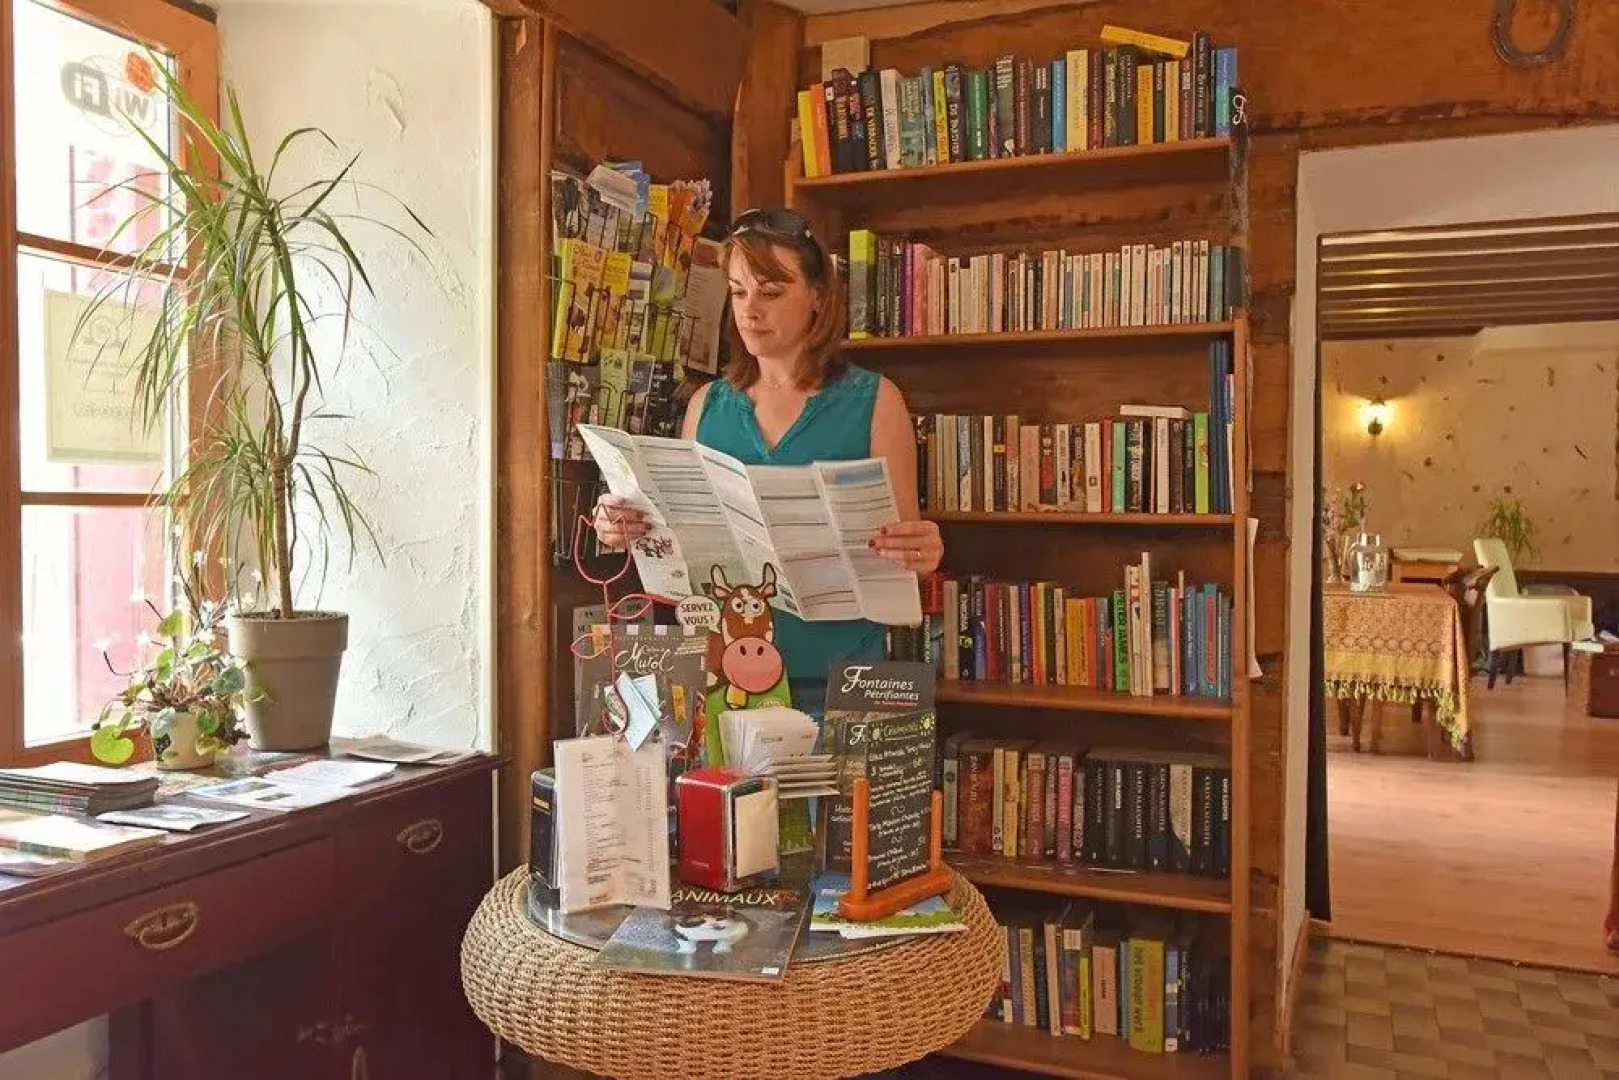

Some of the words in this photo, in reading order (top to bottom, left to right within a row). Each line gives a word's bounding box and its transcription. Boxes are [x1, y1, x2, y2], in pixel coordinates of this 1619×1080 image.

[681, 602, 714, 613] SERVEZ
[1116, 592, 1126, 626] PETER
[1117, 629, 1127, 663] JAMES
[841, 666, 914, 693] Fontaines
[863, 689, 920, 701] Pétrifiantes
[670, 889, 778, 906] ANIMAUX
